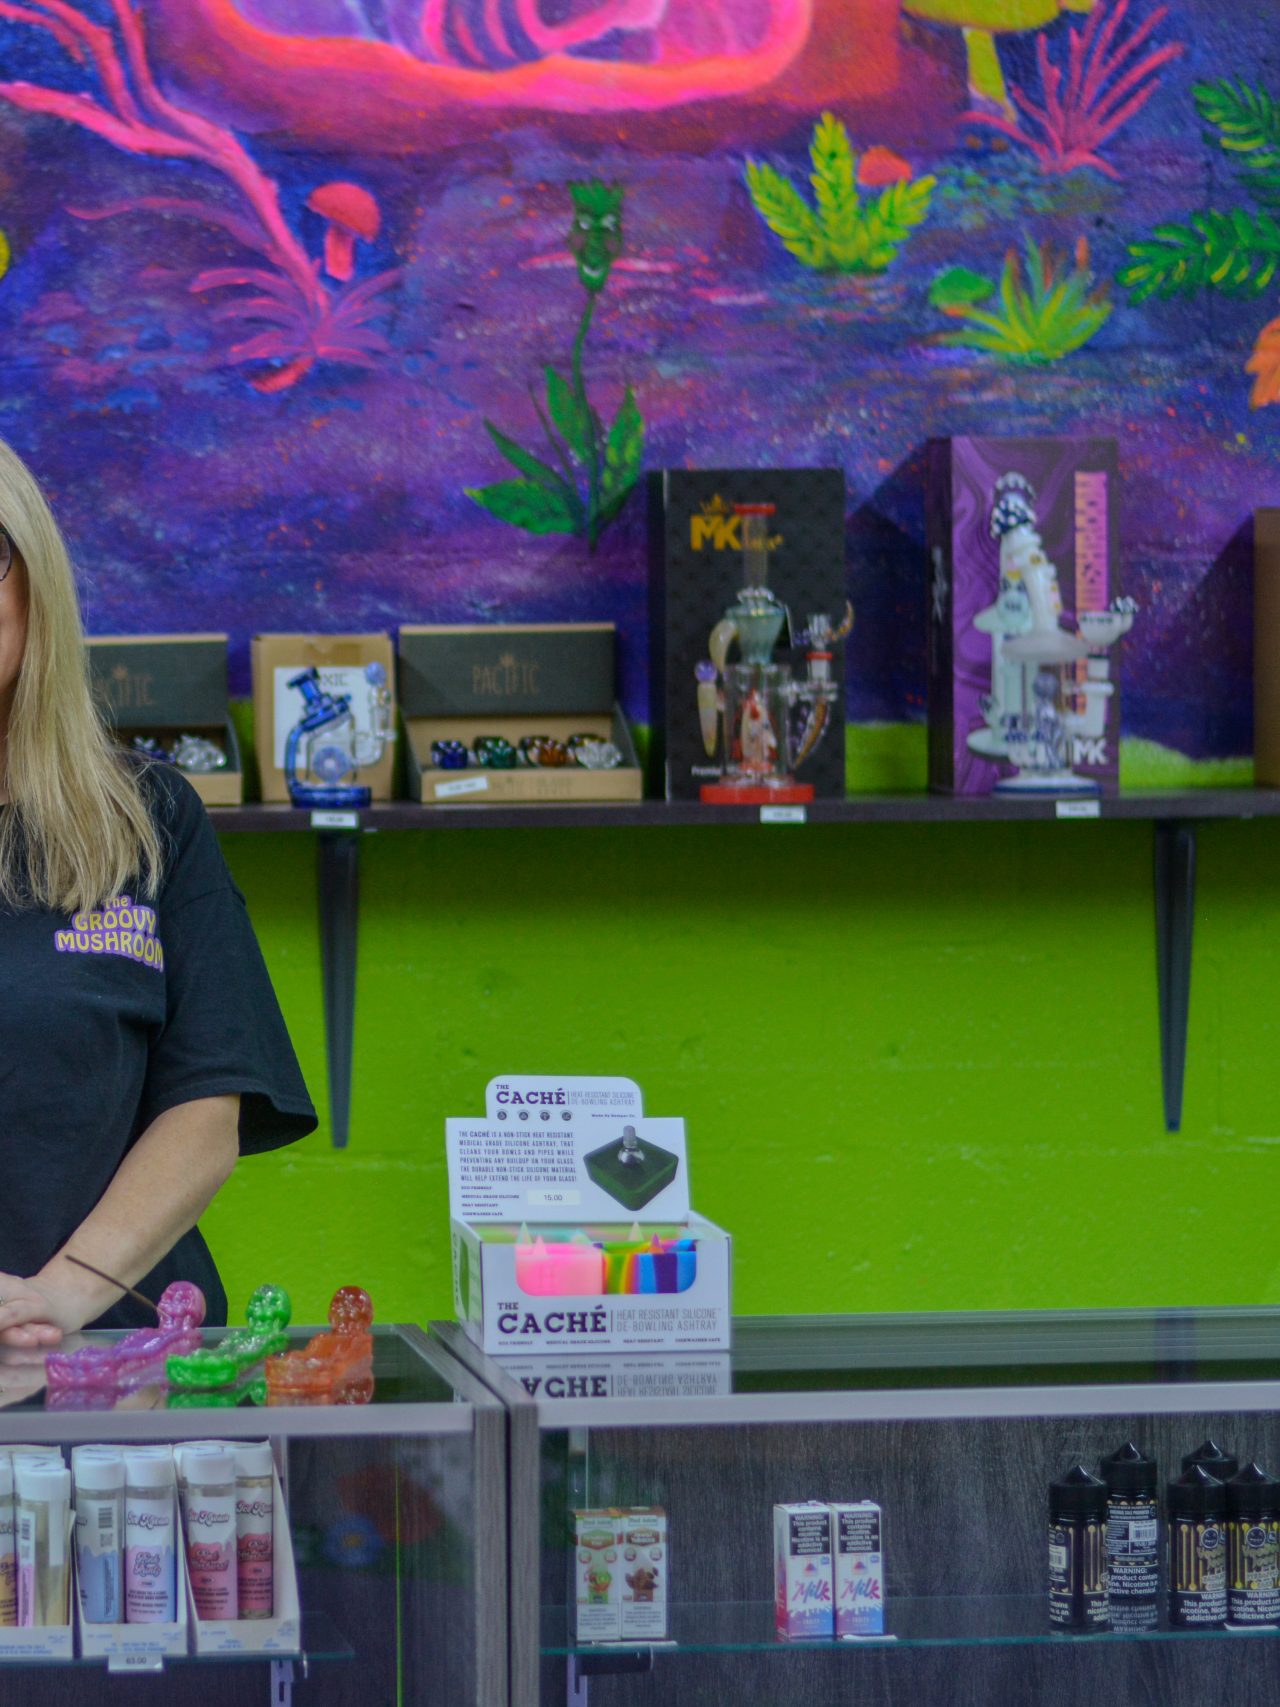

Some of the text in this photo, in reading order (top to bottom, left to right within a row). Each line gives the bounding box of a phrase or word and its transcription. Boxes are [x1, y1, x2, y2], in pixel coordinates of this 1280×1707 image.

[691, 514, 741, 551] MK
[1073, 738, 1107, 765] MK
[104, 897, 128, 909] The
[74, 909, 157, 934] GROOVY
[57, 930, 164, 972] MUSHROOM
[495, 1087, 566, 1105] CACHÉ
[497, 1302, 519, 1310] THE
[497, 1304, 717, 1334] CACHÉ HEAT RESISTANT SILICONE
[617, 1319, 717, 1332] DE-BOWLING ASHTRAY
[854, 1518, 877, 1526] product
[791, 1578, 831, 1604] Milk
[840, 1577, 881, 1602] Milk
[1244, 1597, 1272, 1606] product
[126, 1656, 147, 1664] 63.00
